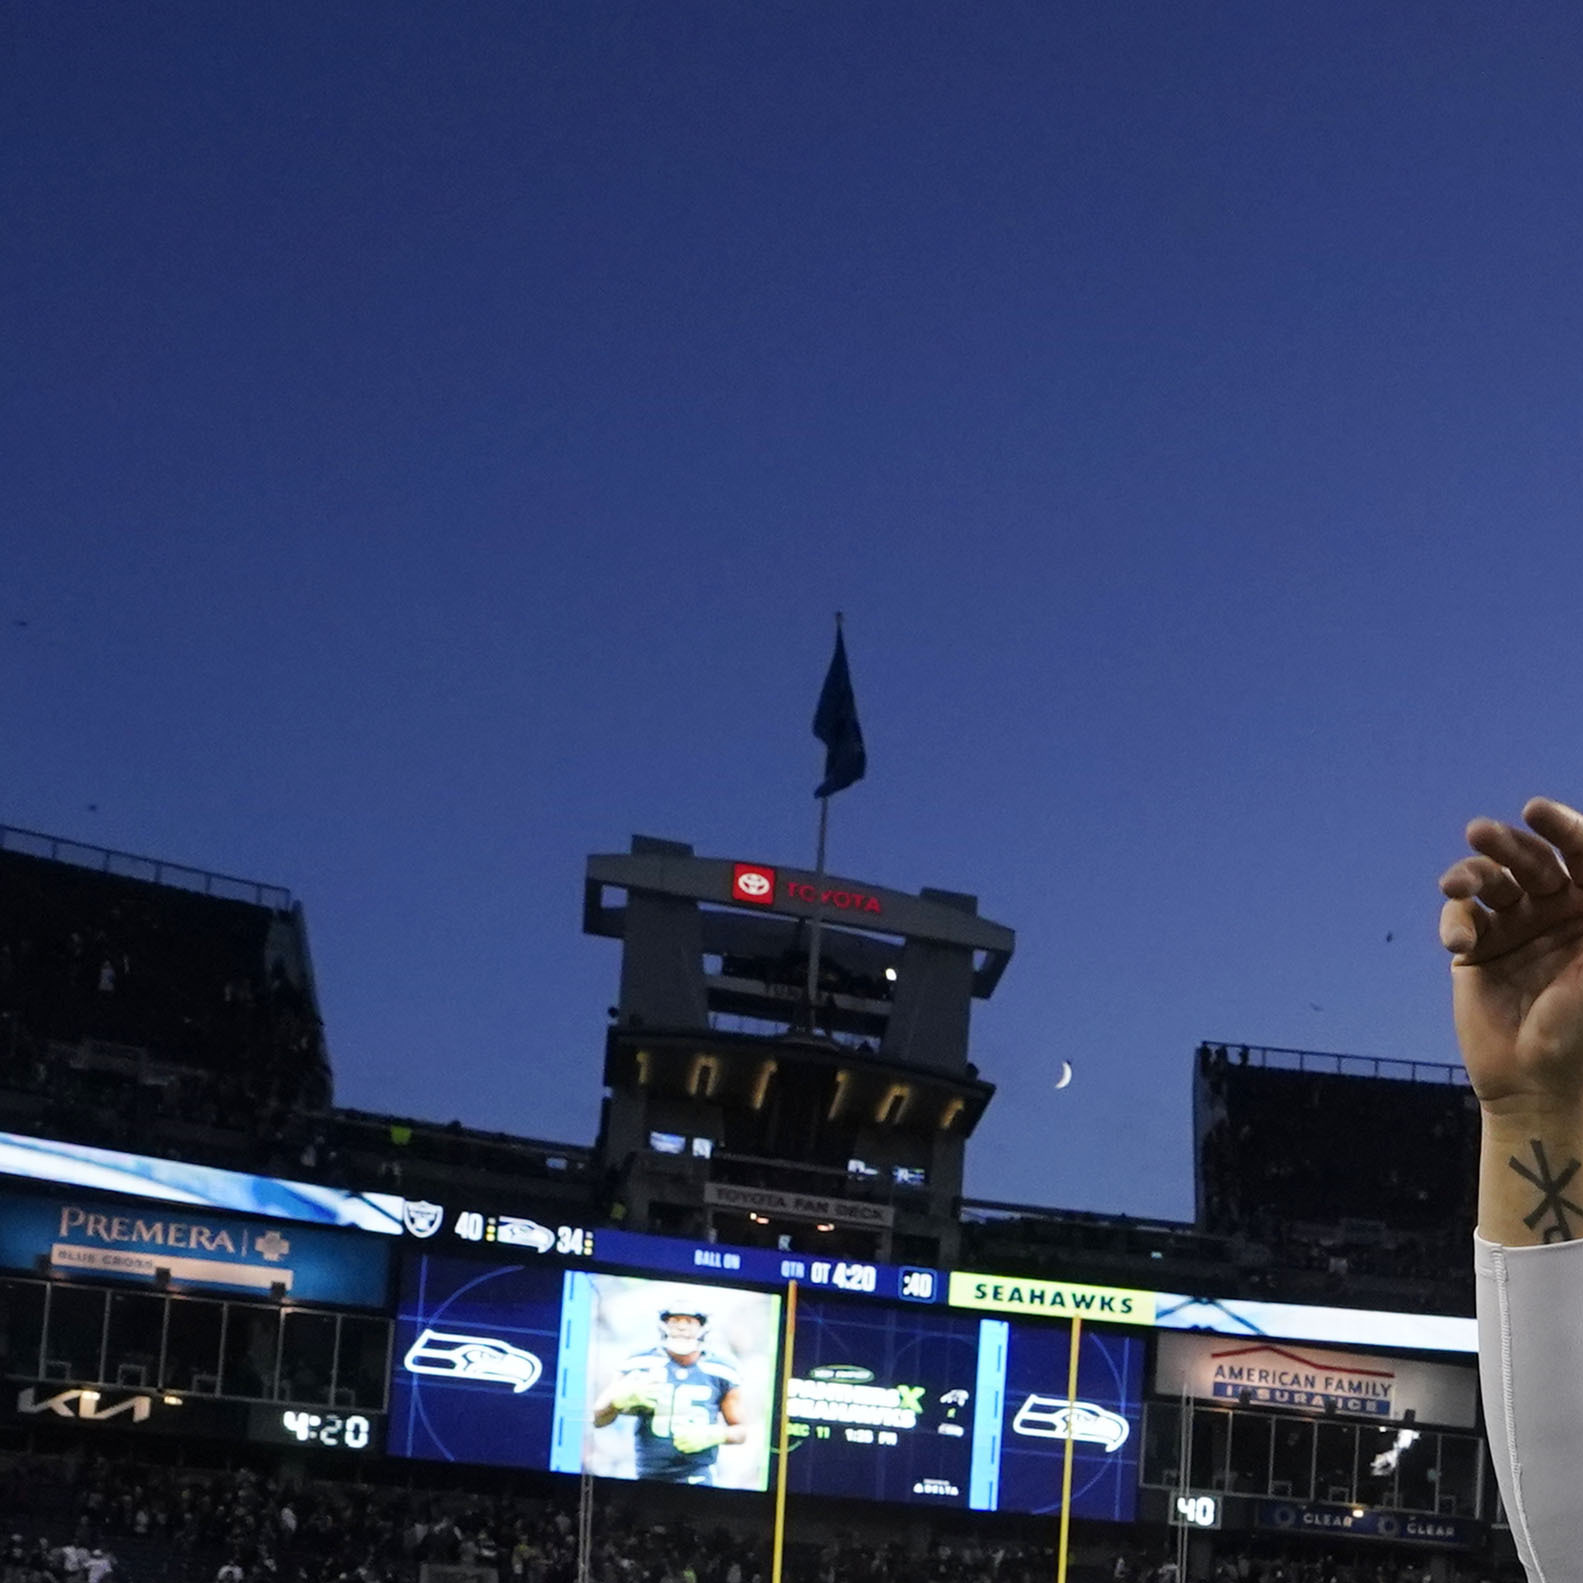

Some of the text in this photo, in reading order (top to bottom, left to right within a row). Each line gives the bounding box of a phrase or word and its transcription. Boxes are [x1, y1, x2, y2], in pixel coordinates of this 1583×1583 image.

[715, 1187, 786, 1208] TOYOTA
[792, 1196, 829, 1213] FAN
[59, 1206, 235, 1254] PREMERA
[454, 1211, 484, 1242] 40
[556, 1226, 584, 1256] 34
[694, 1250, 741, 1271] BALL ON
[781, 1260, 876, 1293] QTR OT 4:20
[975, 1283, 1133, 1314] SEAHAWKS
[1214, 1364, 1392, 1399] AMERICAN FAMILY
[283, 1411, 369, 1448] 4:20
[1177, 1496, 1215, 1526] 40
[1303, 1512, 1353, 1529] CLEAR
[1407, 1522, 1455, 1537] CLEAR
